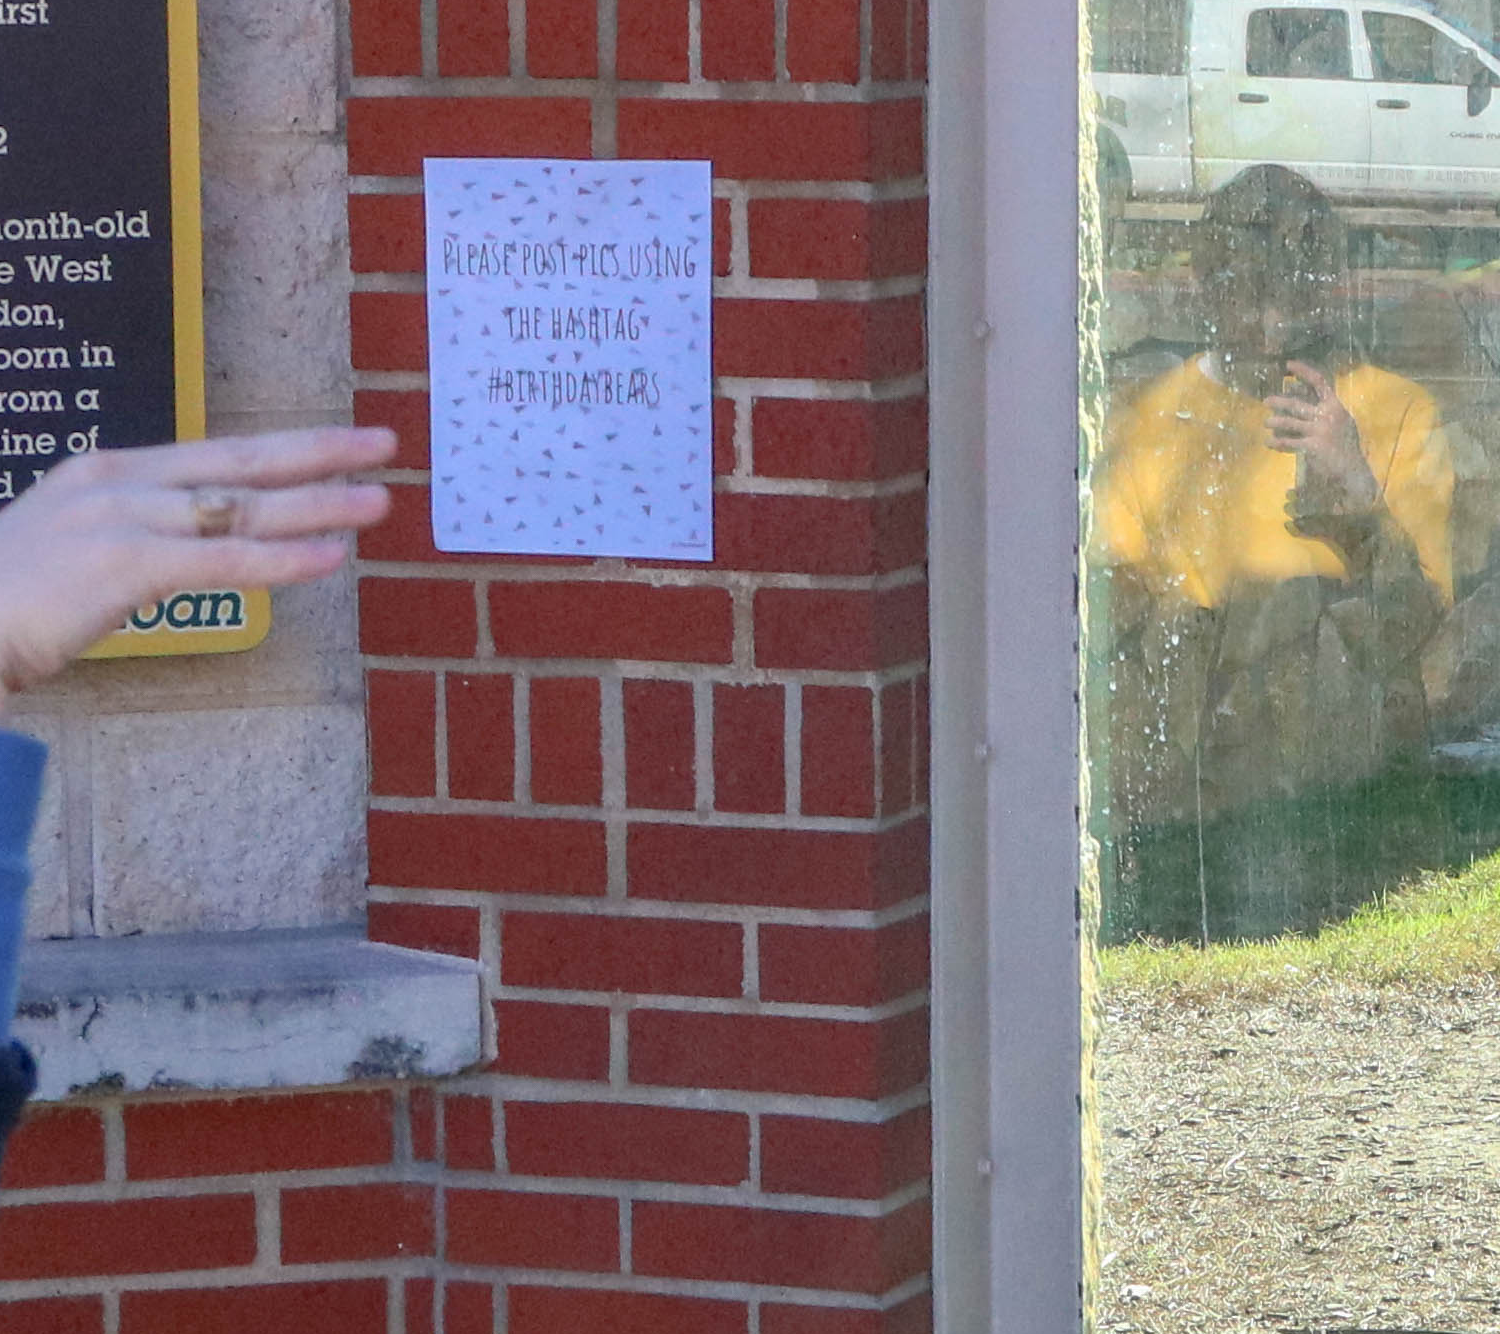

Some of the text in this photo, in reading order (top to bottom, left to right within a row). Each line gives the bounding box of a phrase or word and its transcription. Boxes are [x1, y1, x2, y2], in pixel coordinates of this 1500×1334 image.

[24, 252, 113, 284] West
[443, 239, 697, 278] PLEASE POST PICS USING
[504, 306, 641, 342] THE HASHTAG
[74, 388, 100, 412] a
[488, 367, 661, 406] #BIRTHDAYBEARS
[66, 424, 101, 455] of
[123, 591, 244, 630] oan
